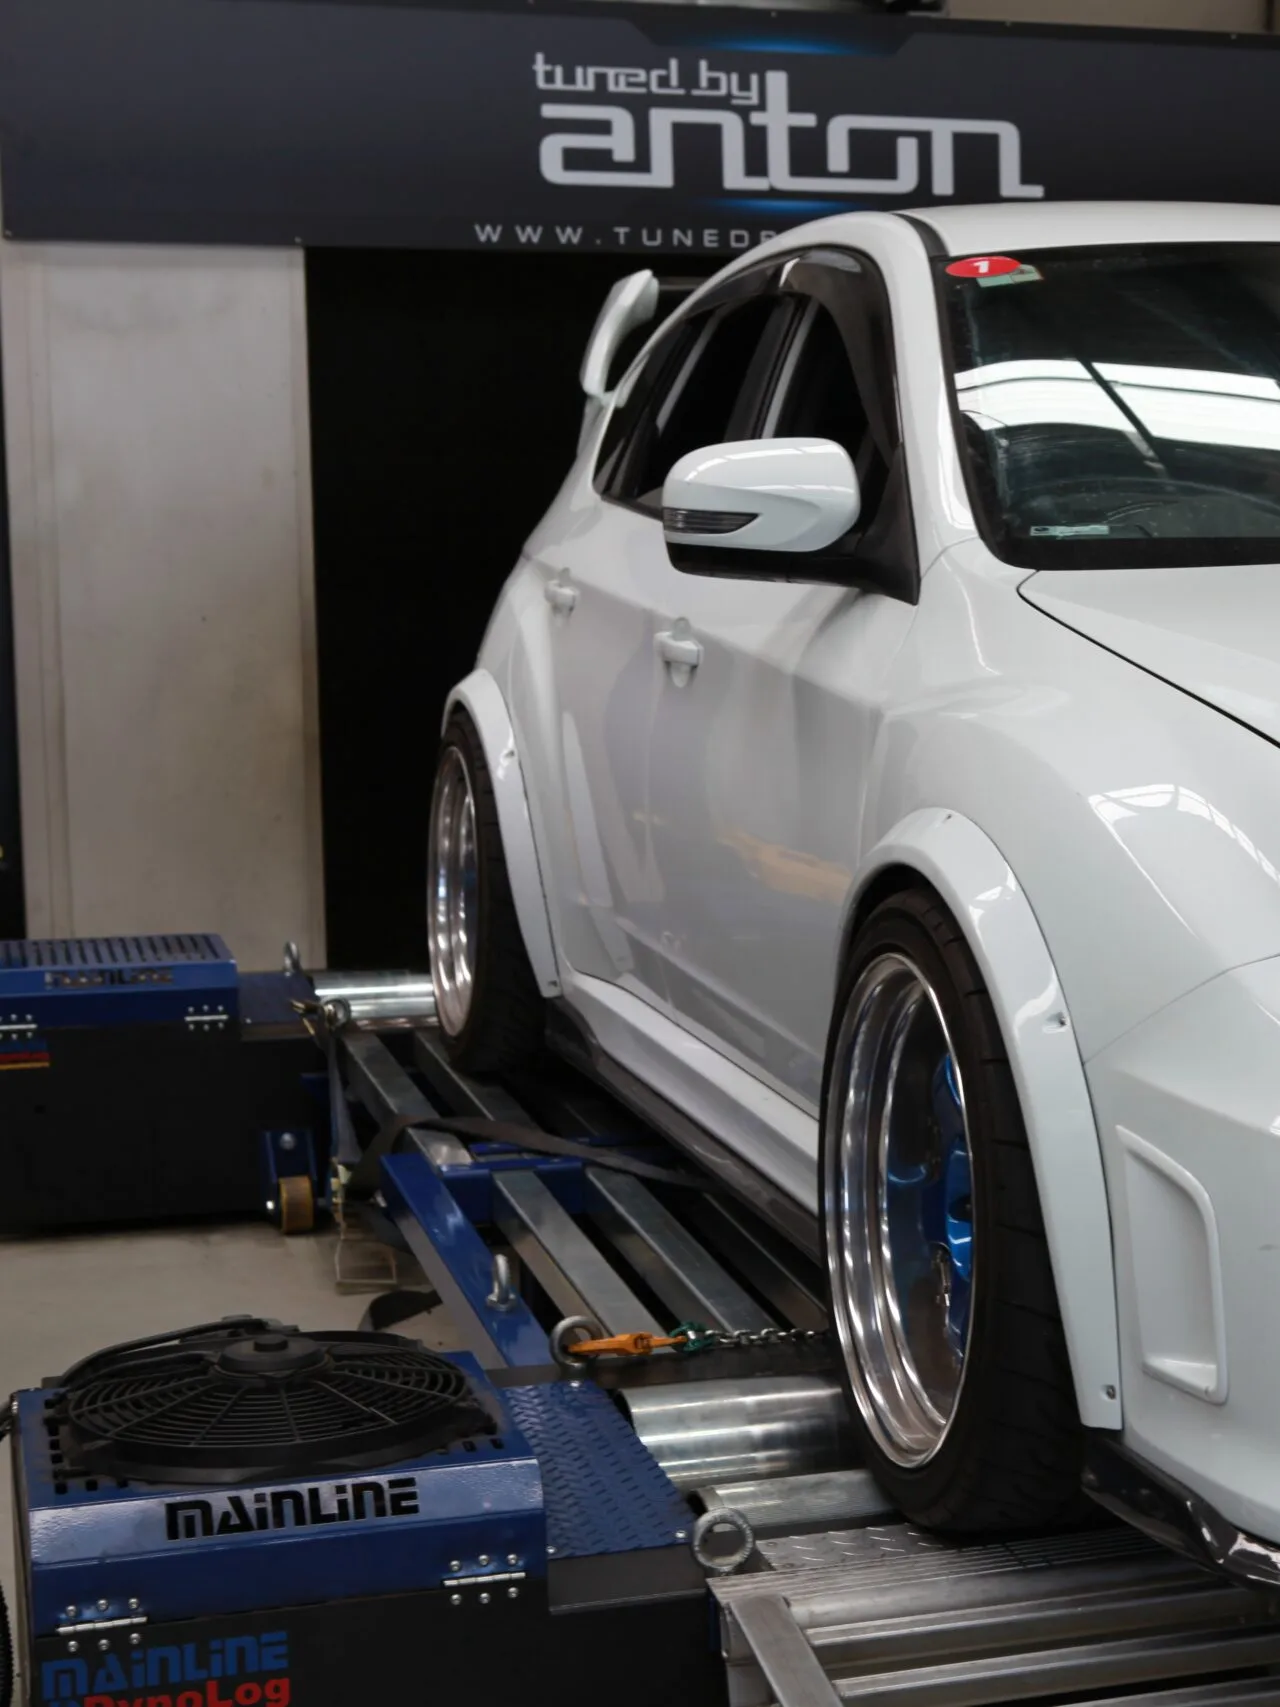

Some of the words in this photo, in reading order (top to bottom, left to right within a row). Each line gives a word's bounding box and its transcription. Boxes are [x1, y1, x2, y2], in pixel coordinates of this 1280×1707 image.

[532, 52, 685, 96] tuned
[691, 58, 760, 105] by
[539, 70, 1045, 199] anton
[973, 260, 990, 274] 1
